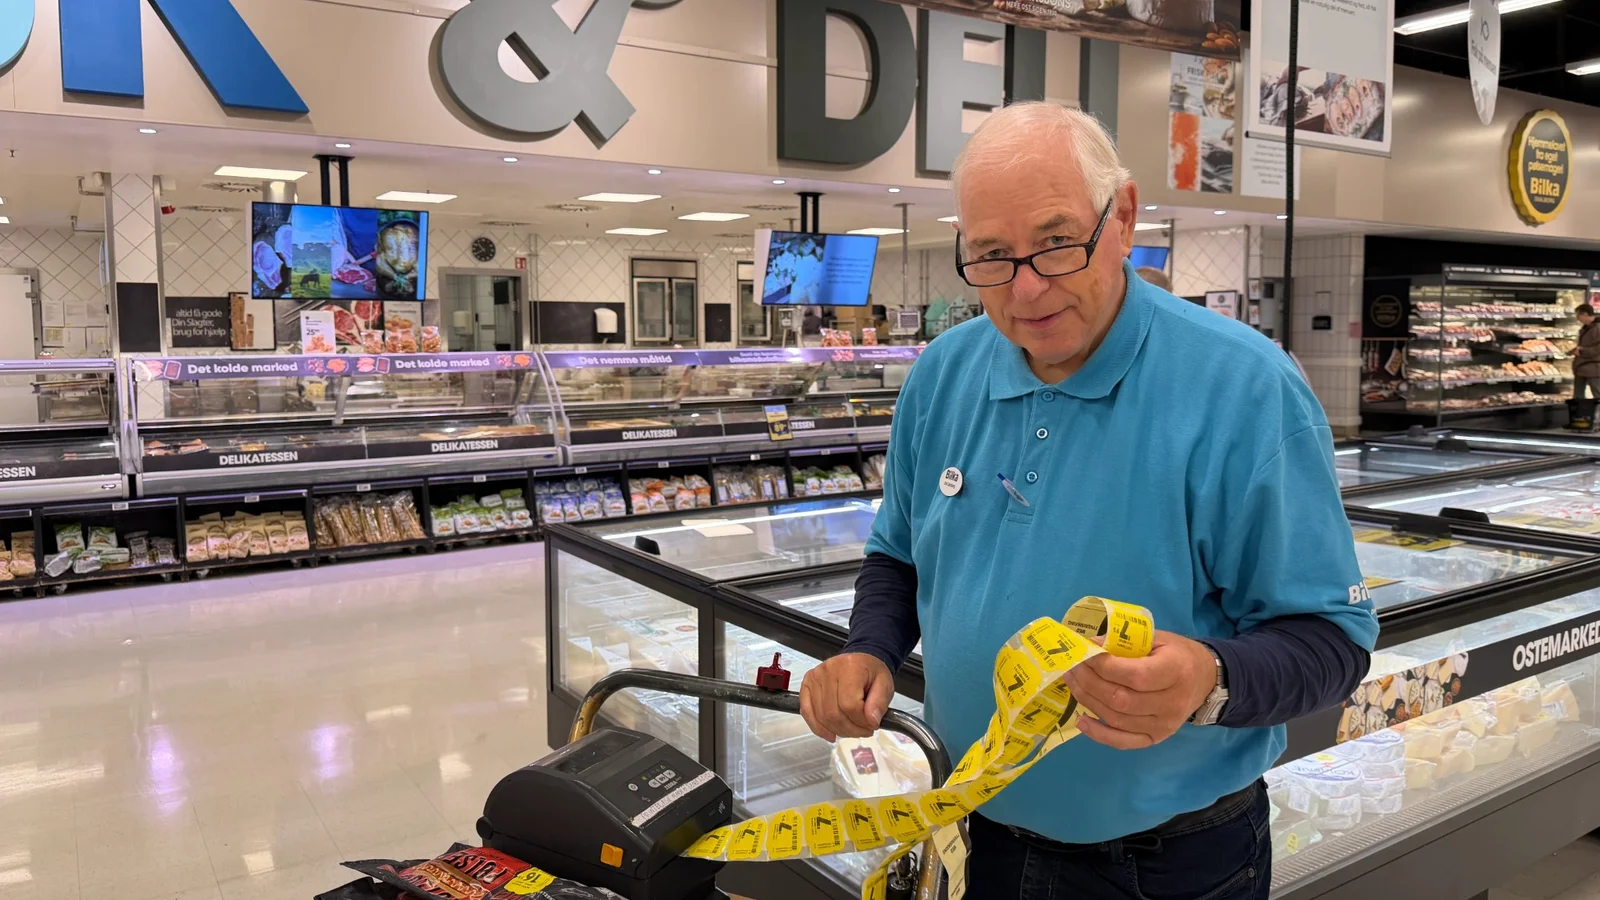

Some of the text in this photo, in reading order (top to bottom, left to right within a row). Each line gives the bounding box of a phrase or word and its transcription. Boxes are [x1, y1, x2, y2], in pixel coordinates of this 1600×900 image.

[1530, 177, 1559, 197] Bilka
[176, 309, 193, 317] altid
[202, 309, 222, 319] gode
[172, 319, 186, 327] Din
[172, 329, 192, 337] brug
[193, 327, 204, 336] for
[395, 358, 490, 369] Det kolde marked
[580, 356, 599, 365] Det
[640, 355, 673, 364] måltid
[187, 362, 298, 374] Det kolde marked
[791, 420, 815, 430] TESSEN
[622, 428, 677, 440] DELIKATESSEN
[431, 440, 498, 452] DELIKATESSEN
[219, 451, 298, 466] DELIKATESSEN
[945, 469, 959, 482] Bilka
[1047, 641, 1069, 655] 7
[1008, 676, 1024, 692] 7
[854, 812, 869, 823] 7
[892, 809, 909, 820] 7
[779, 822, 792, 834] 7
[817, 816, 832, 829] 7
[526, 872, 541, 883] 16
